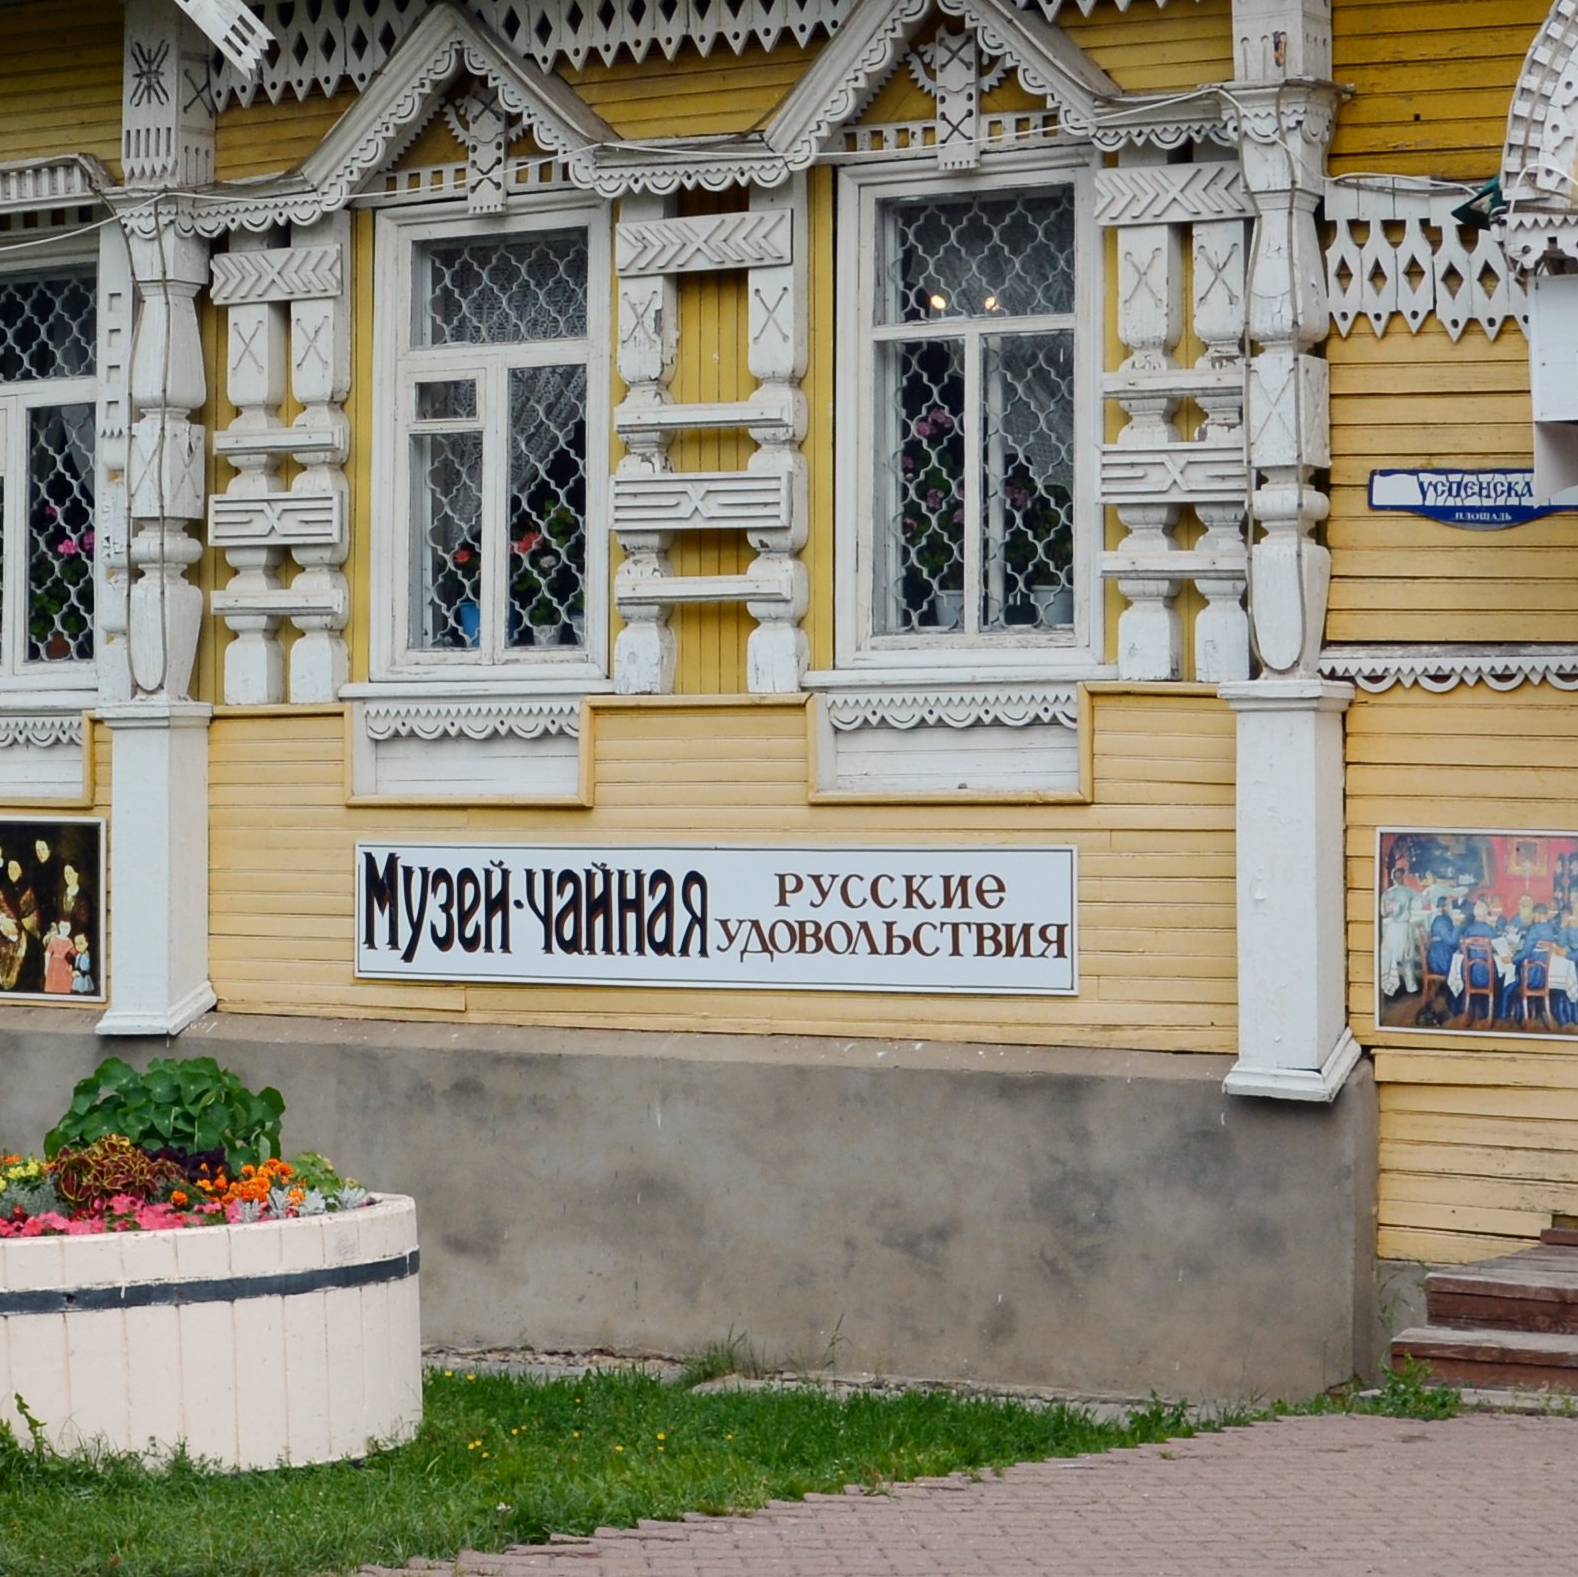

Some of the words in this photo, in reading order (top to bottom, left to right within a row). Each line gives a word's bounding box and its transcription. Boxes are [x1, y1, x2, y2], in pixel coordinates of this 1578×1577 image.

[1421, 479, 1534, 502] УСПЕНСКА
[1455, 511, 1512, 521] ПЛОЩАДЬ
[715, 918, 1069, 963] УДОВОЛЬСТВИЯ
